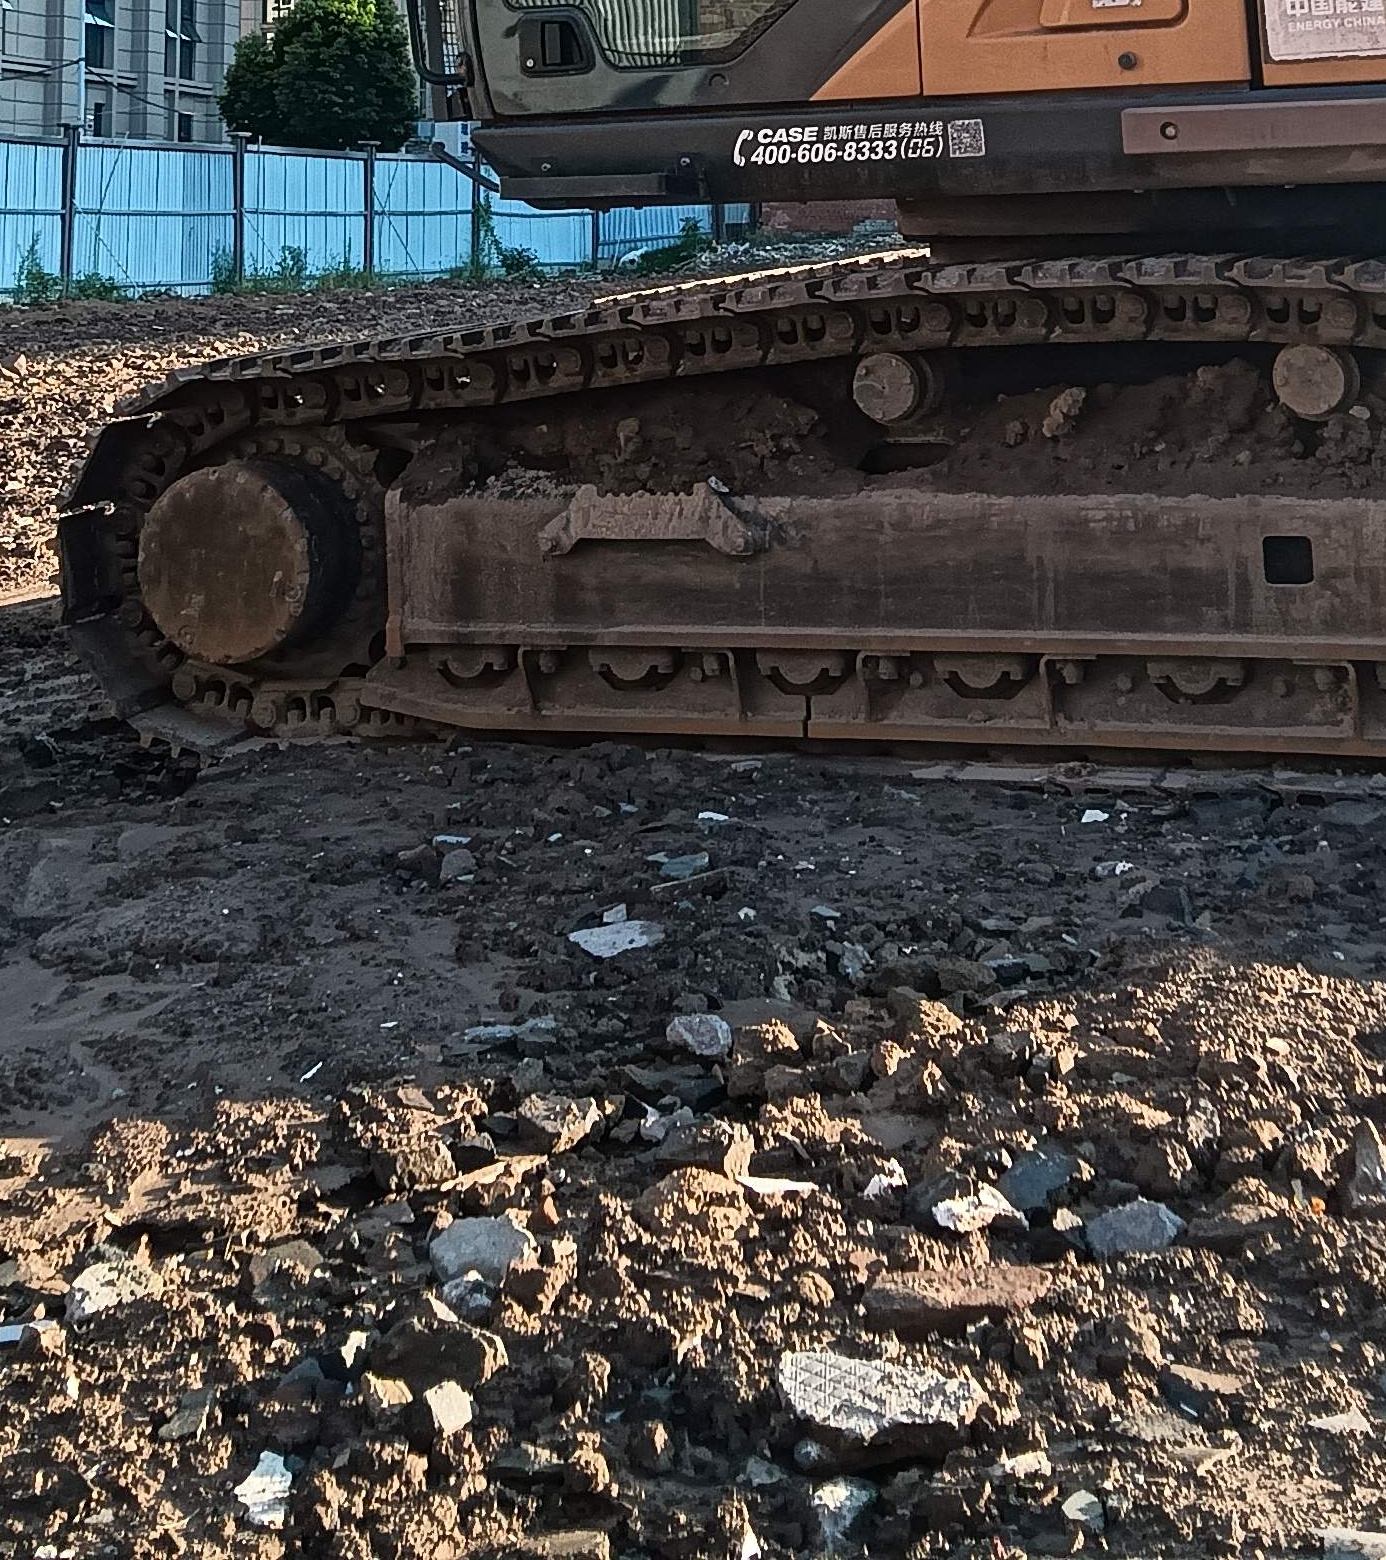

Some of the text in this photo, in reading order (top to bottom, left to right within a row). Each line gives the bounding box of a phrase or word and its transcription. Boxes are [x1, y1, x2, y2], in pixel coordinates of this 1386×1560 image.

[1288, 15, 1386, 32] ENERGY CHINA
[756, 126, 819, 144] CASE
[823, 120, 944, 141] 凯斯售后服务热线
